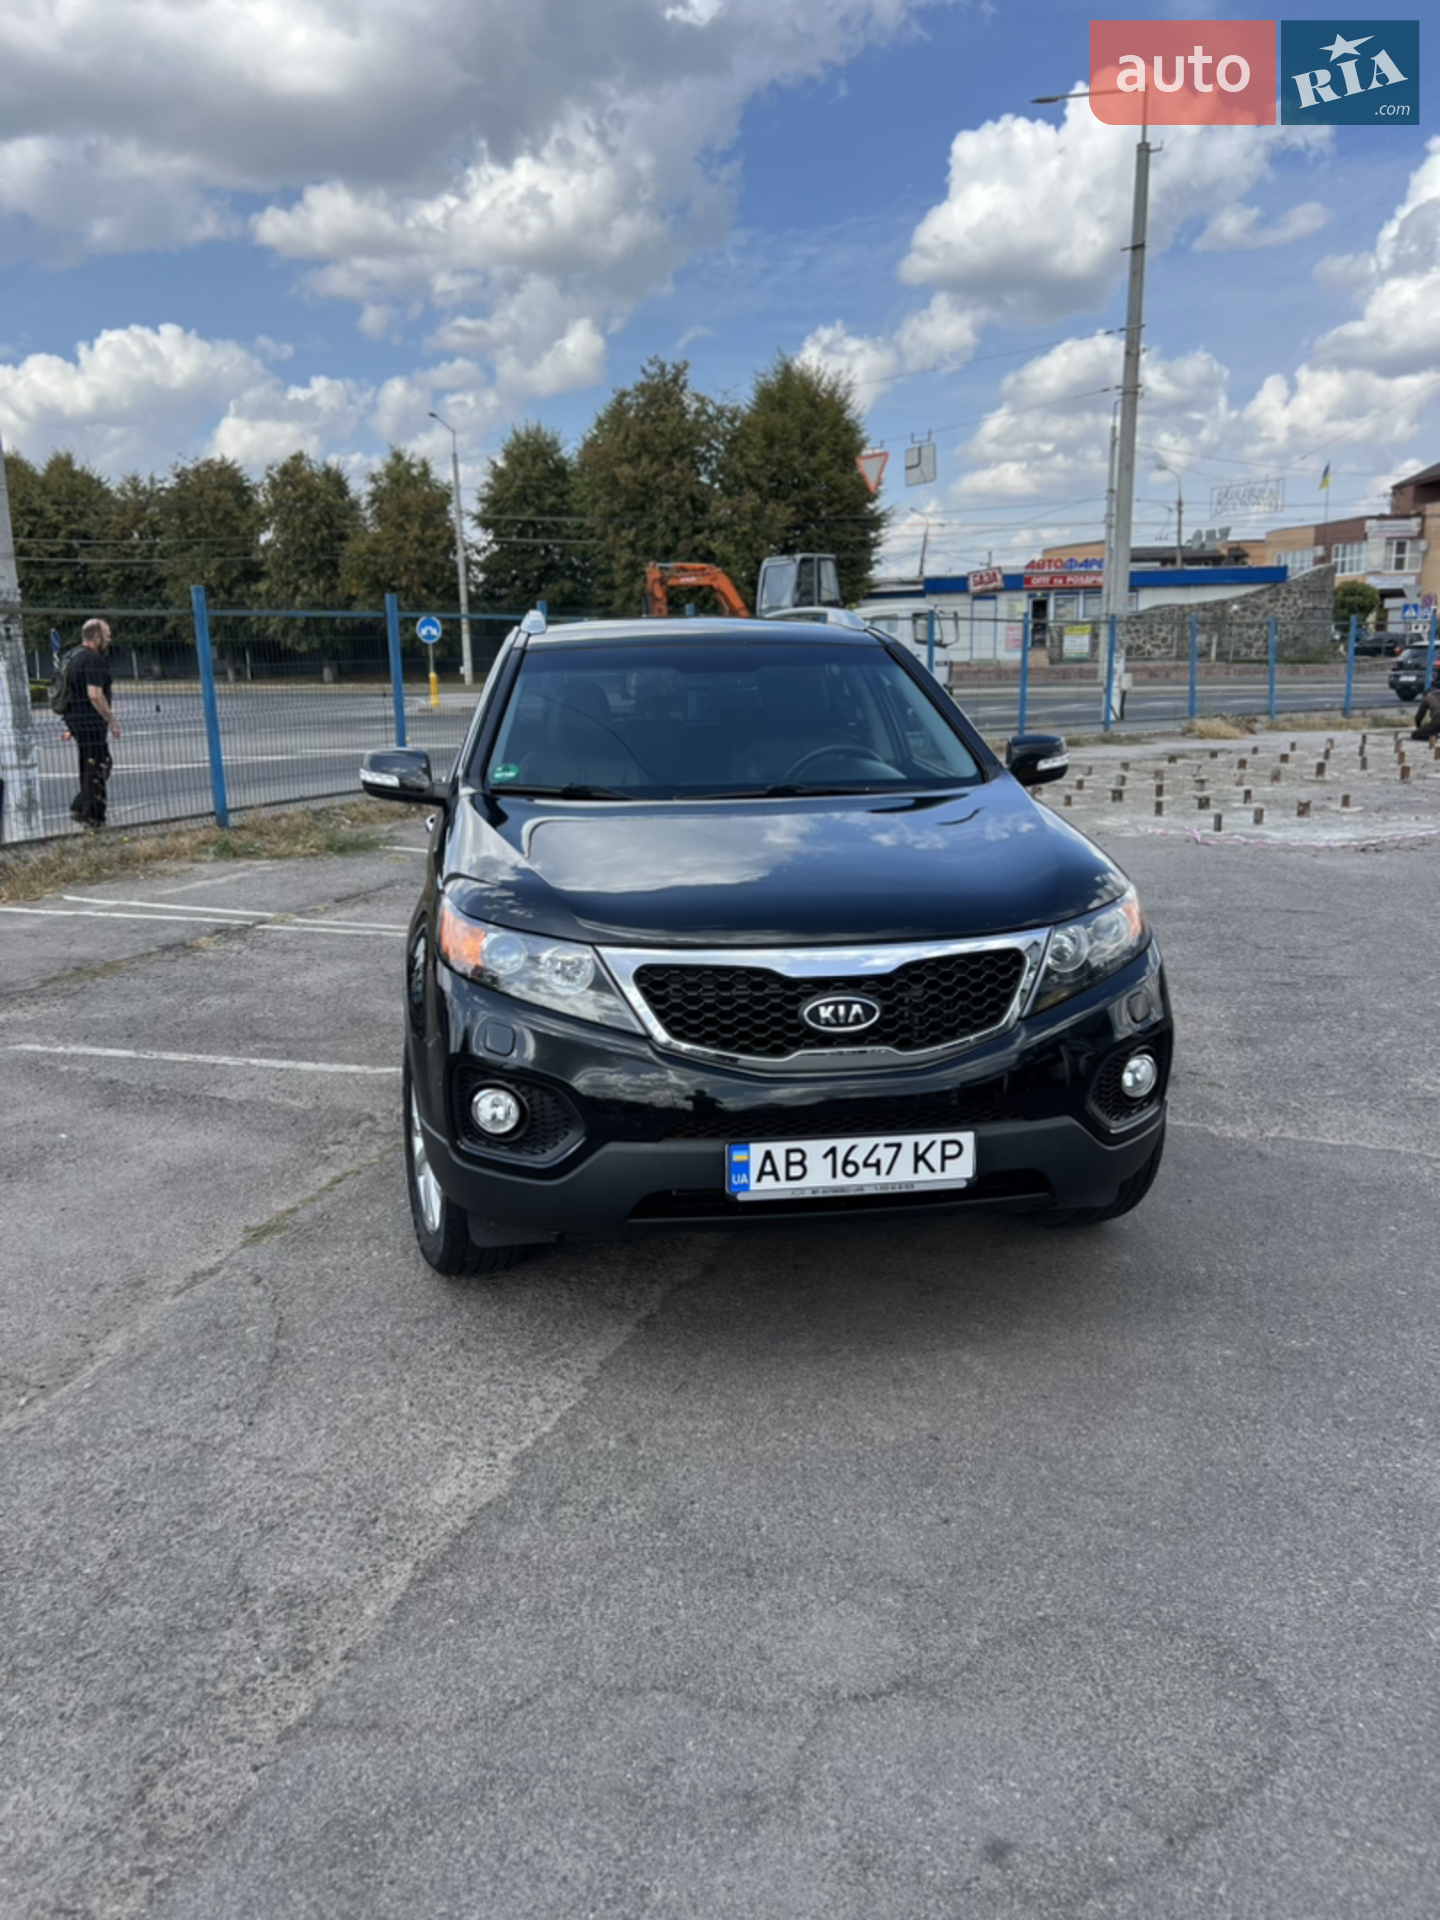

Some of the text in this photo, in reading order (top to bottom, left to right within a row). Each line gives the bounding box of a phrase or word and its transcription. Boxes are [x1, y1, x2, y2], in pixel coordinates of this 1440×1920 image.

[973, 571, 999, 588] БАЗА
[818, 1003, 866, 1025] KIA
[756, 1139, 964, 1183] AB 1647 KP
[731, 1173, 749, 1185] UA
